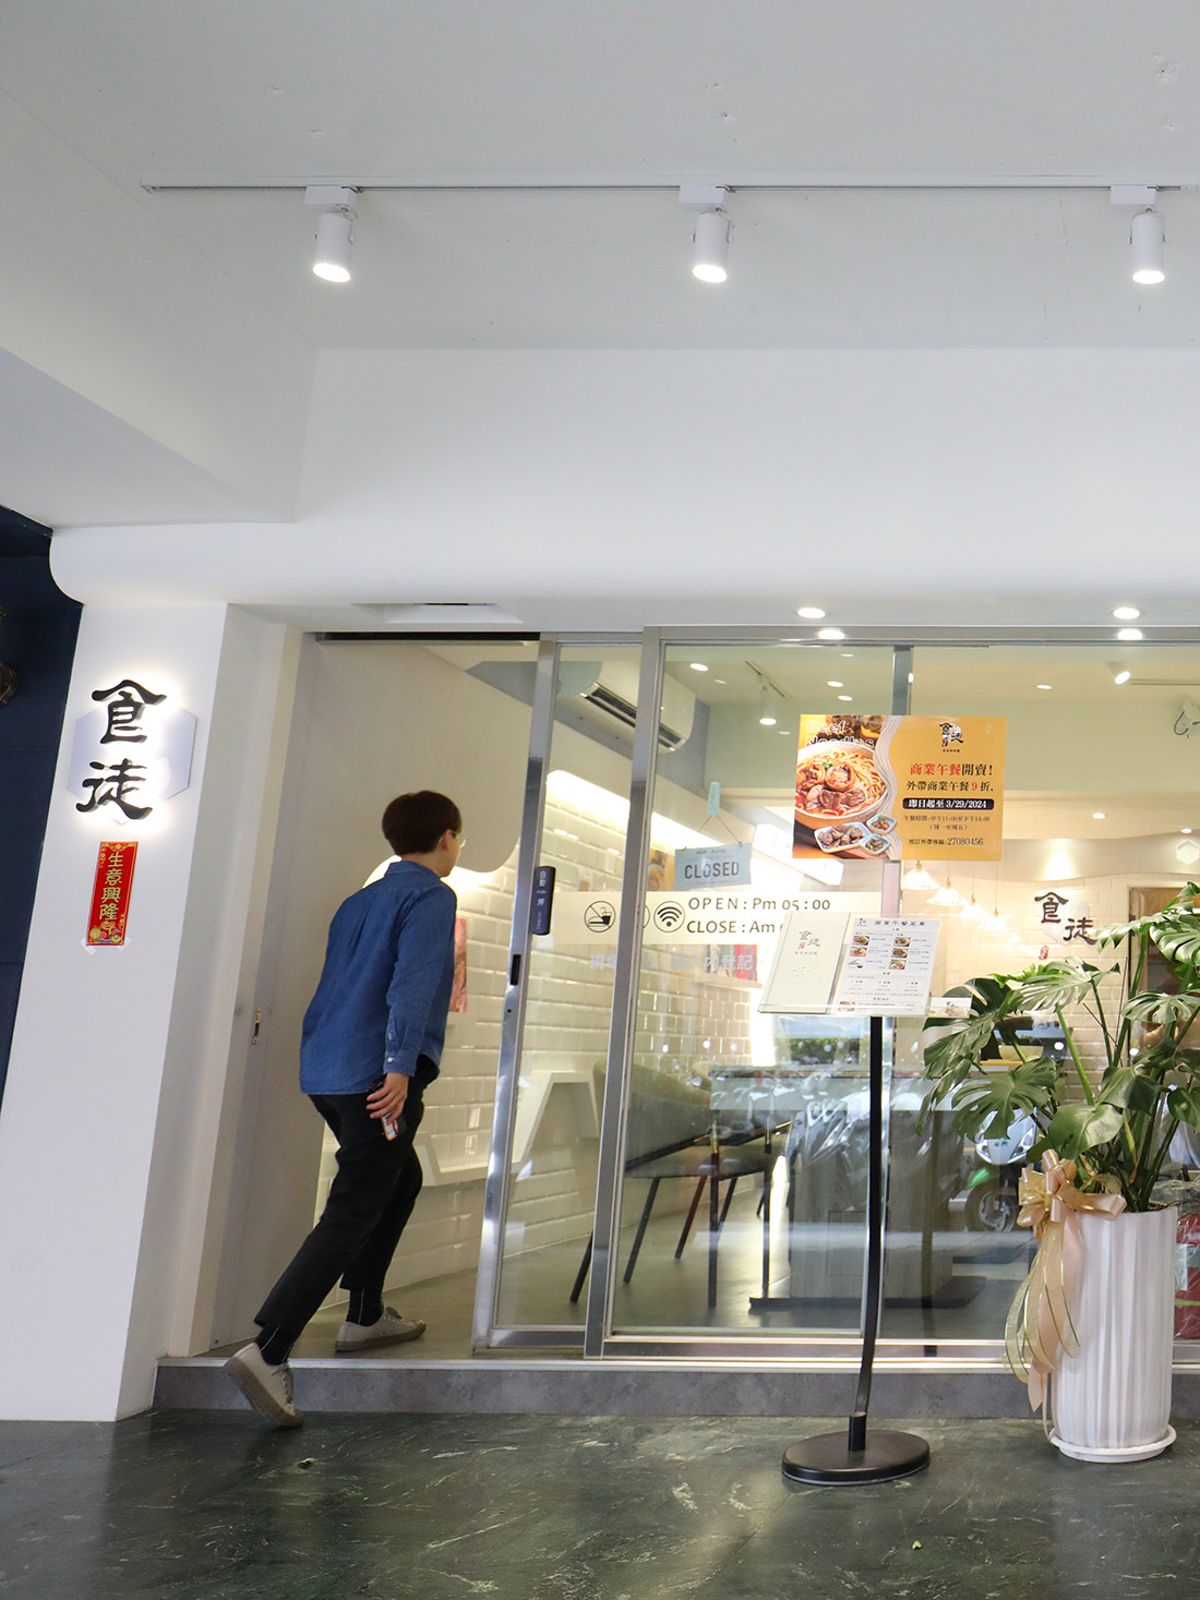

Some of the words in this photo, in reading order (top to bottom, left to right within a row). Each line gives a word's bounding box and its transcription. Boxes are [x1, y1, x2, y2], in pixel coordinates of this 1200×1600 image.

[76, 679, 168, 821] 食徒
[99, 851, 124, 920] 生意興隆
[684, 861, 740, 879] CLOSED
[752, 897, 777, 911] Pm
[1034, 891, 1098, 946] 食徒
[749, 920, 776, 934] Am
